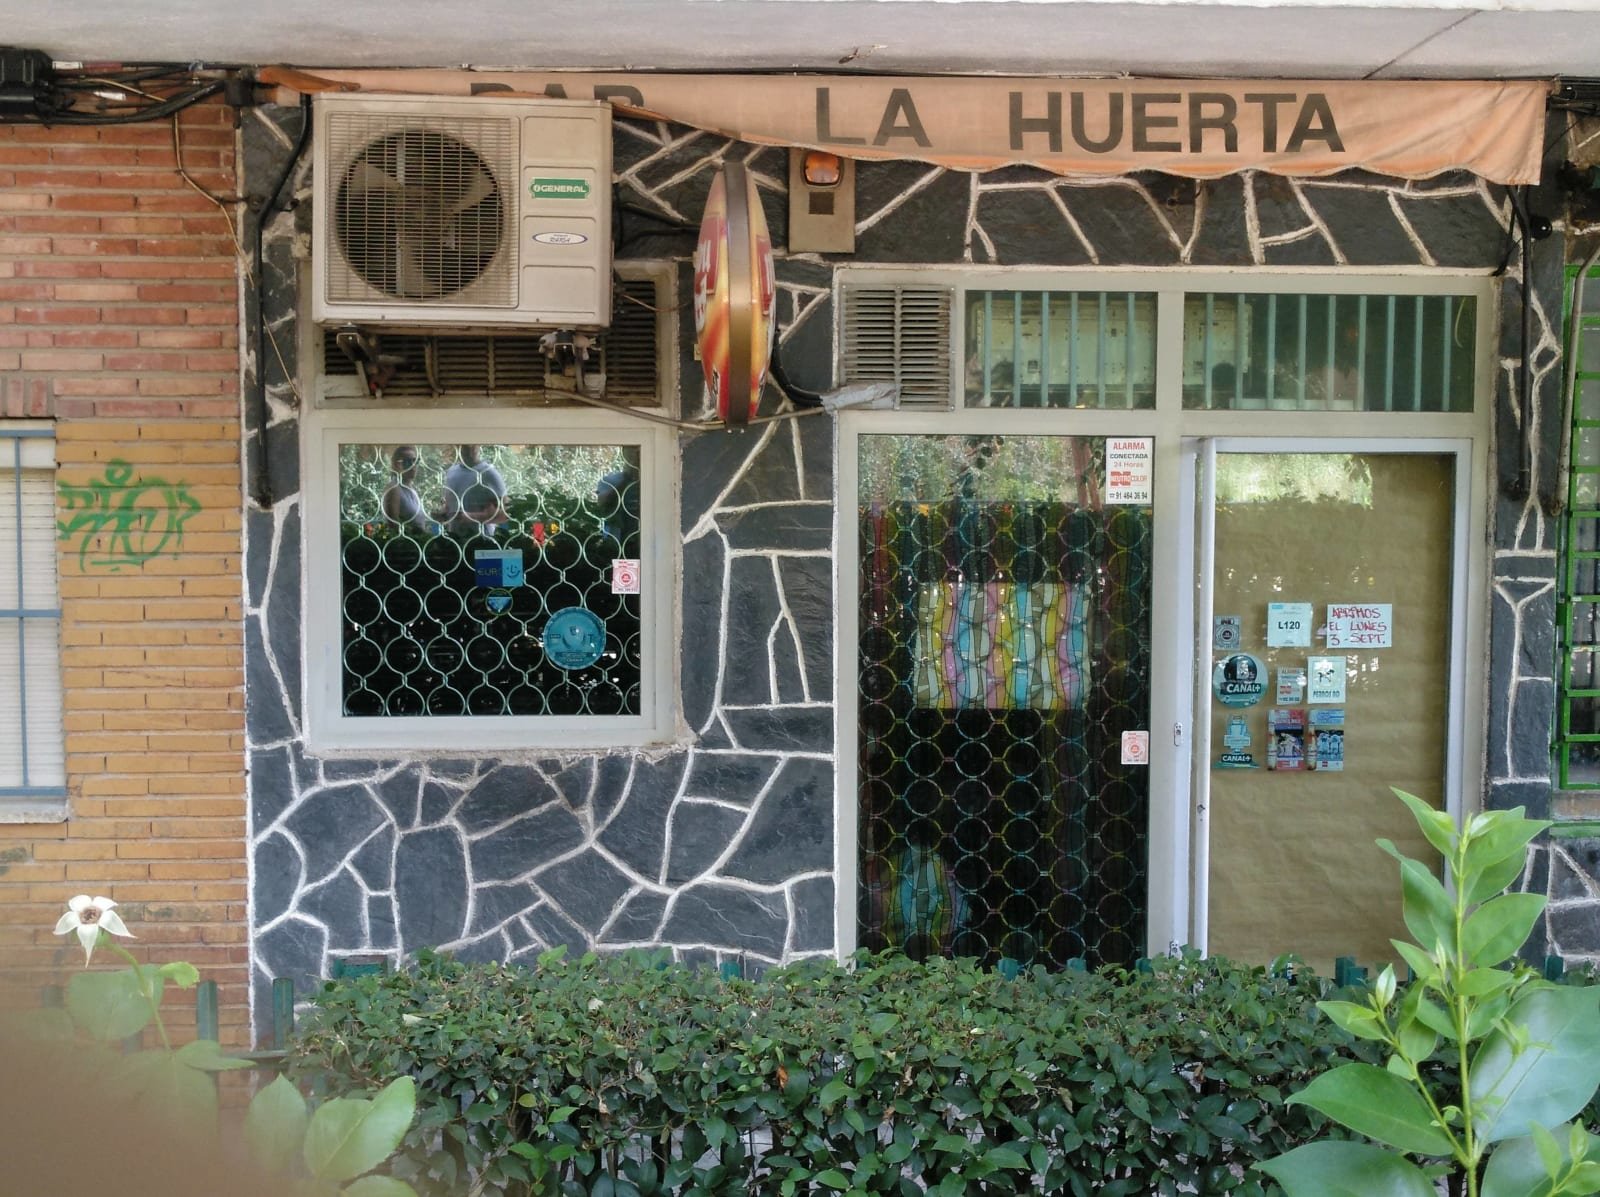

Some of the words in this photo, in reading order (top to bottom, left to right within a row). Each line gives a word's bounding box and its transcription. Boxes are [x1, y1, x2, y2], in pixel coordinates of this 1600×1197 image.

[815, 86, 933, 148] LA
[1008, 90, 1346, 154] HUERTA
[1113, 442, 1145, 450] ALARMA
[1278, 621, 1301, 630] L120
[1329, 621, 1342, 631] EL
[1350, 621, 1387, 632] LUNES
[1329, 633, 1341, 646] 3
[1226, 683, 1261, 693] CANAL+
